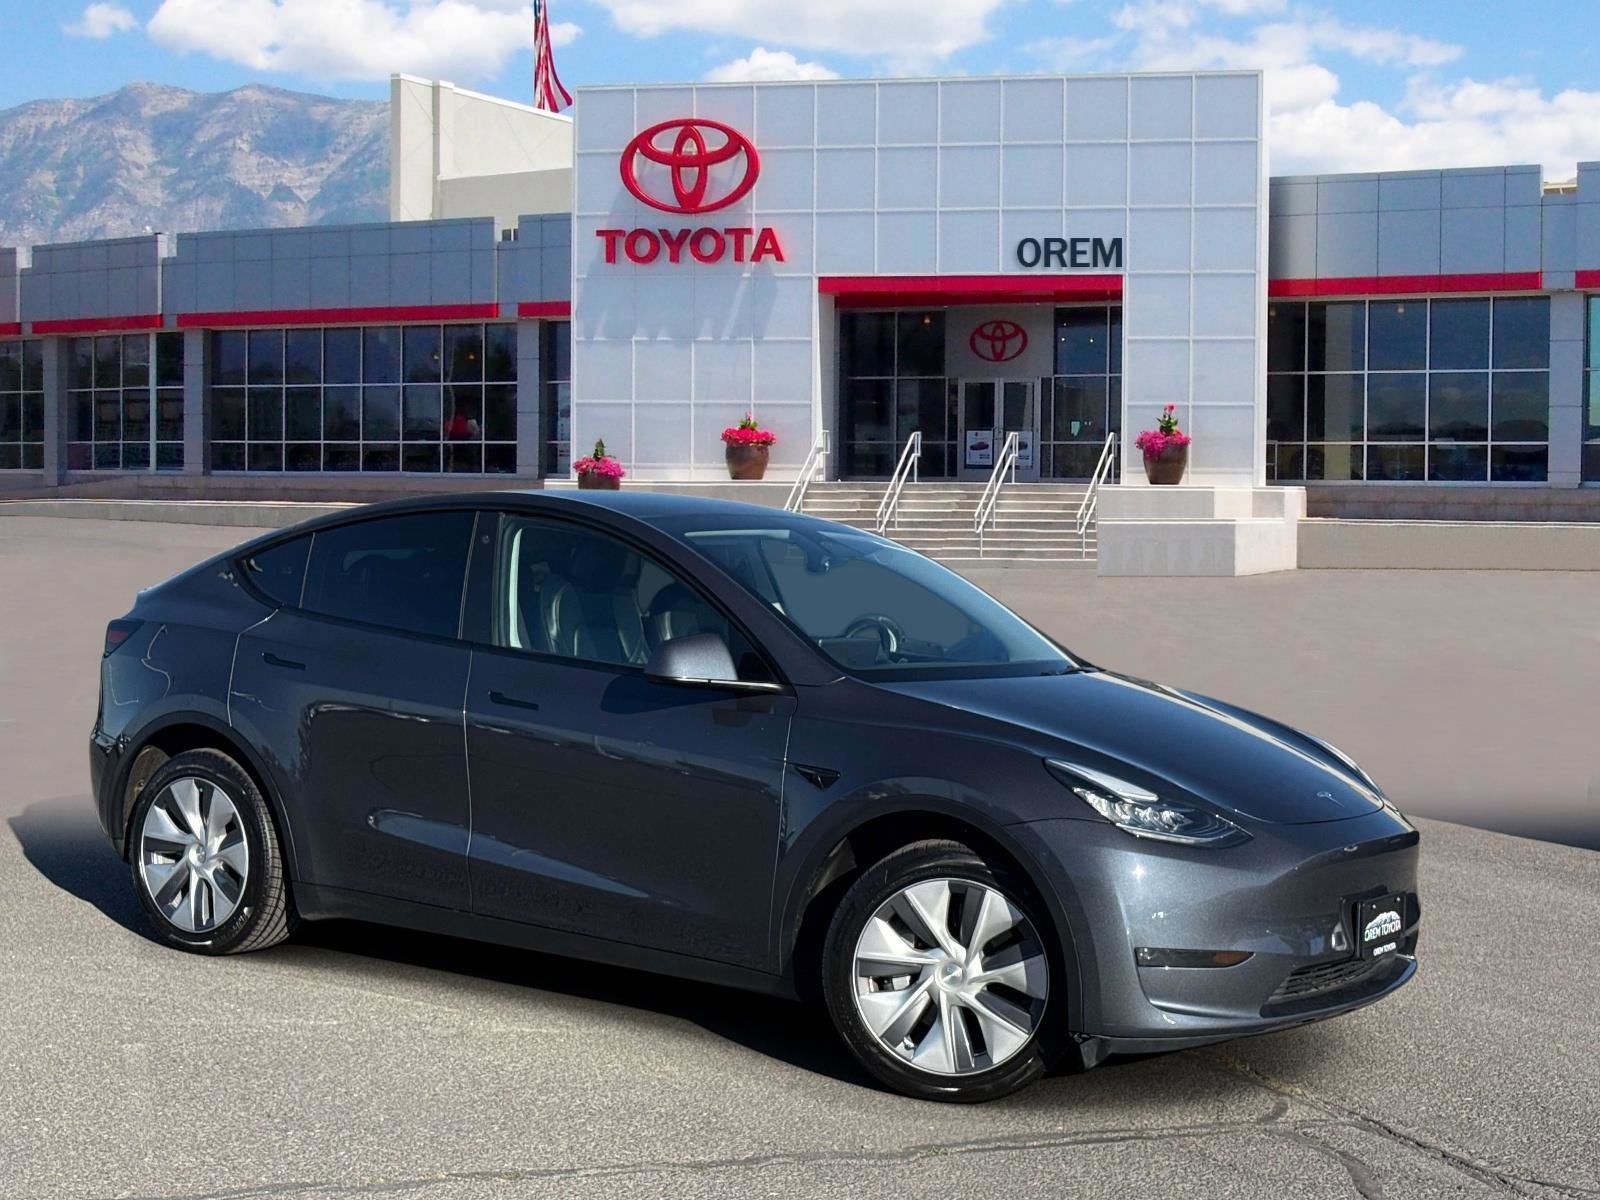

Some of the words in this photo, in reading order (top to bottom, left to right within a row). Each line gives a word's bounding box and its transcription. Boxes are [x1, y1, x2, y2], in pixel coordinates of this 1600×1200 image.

[595, 227, 785, 265] TOYOTA
[1017, 237, 1123, 268] OREM
[1364, 926, 1381, 942] OREM
[1381, 919, 1402, 936] TOYOTA
